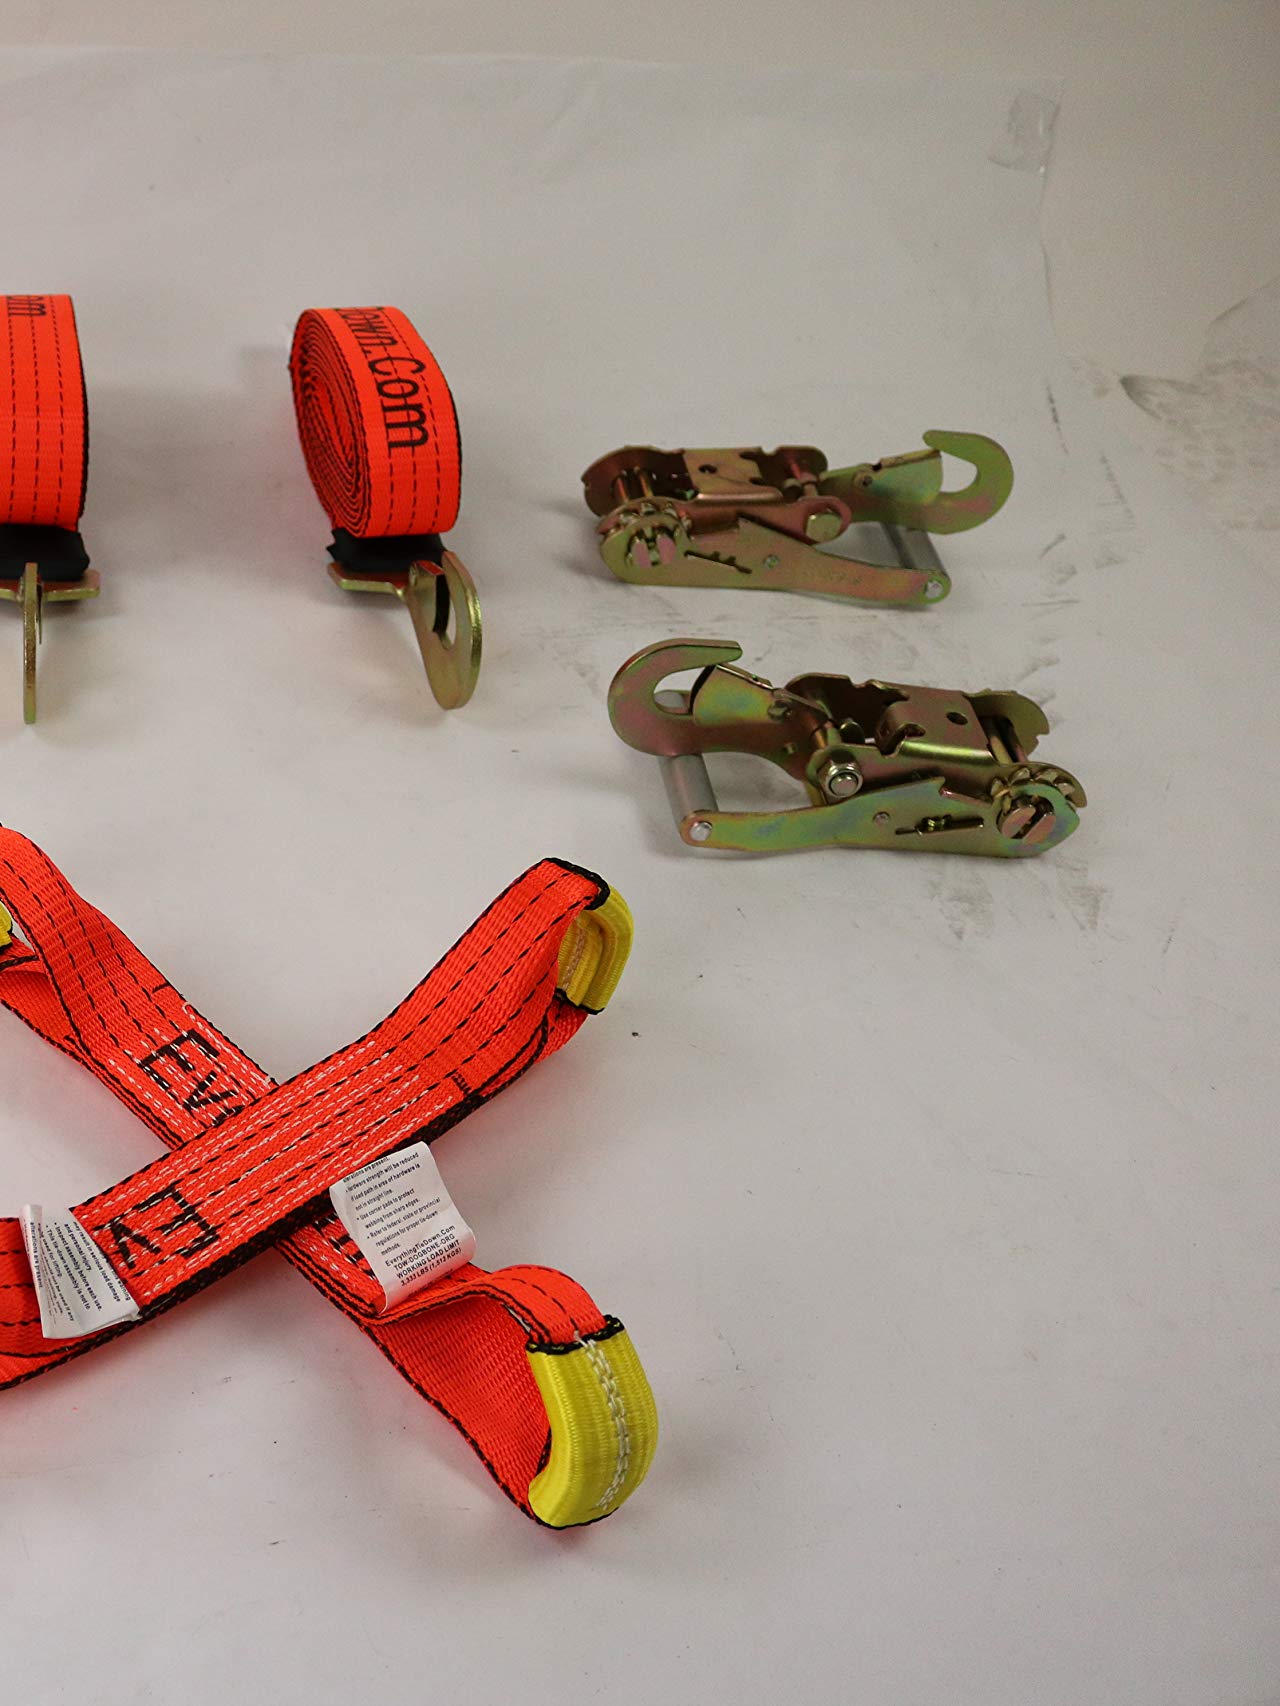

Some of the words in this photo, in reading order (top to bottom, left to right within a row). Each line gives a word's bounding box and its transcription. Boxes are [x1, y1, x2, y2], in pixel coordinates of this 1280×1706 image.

[333, 308, 429, 449] own.Com
[353, 1191, 363, 1199] load
[362, 1186, 373, 1195] path
[378, 1179, 388, 1187] area
[392, 1165, 415, 1179] hardware
[365, 1169, 384, 1183] strength
[383, 1165, 393, 1173] will
[398, 1152, 419, 1165] reduced
[364, 1216, 383, 1229] webbing
[382, 1211, 393, 1219] from
[392, 1204, 405, 1215] sharp
[404, 1196, 420, 1208] edges.
[366, 1192, 384, 1205] straight
[368, 1205, 382, 1215] corner
[381, 1199, 393, 1209] pads
[397, 1188, 415, 1200] protect
[369, 1227, 382, 1237] Refer
[402, 1211, 413, 1220] state
[417, 1197, 441, 1213] provincial
[29, 1221, 37, 1253] alterations
[63, 1222, 72, 1233] and
[68, 1232, 84, 1256] personal
[80, 1255, 93, 1272] injury.
[374, 1230, 400, 1248] regulations
[405, 1220, 421, 1232] proper
[418, 1210, 438, 1223] tie-down
[385, 1224, 455, 1267] EverythingTieDown.Com
[46, 1229, 55, 1241] This
[51, 1240, 67, 1264] tie-down
[62, 1263, 80, 1289] assembly
[79, 1293, 88, 1304] not
[84, 1302, 91, 1310] to
[53, 1226, 68, 1246] Inspect
[64, 1245, 81, 1270] assembly
[77, 1269, 90, 1286] before
[86, 1286, 97, 1299] each
[93, 1299, 102, 1311] use.
[78, 1230, 90, 1246] result
[90, 1250, 103, 1270] serious
[100, 1269, 110, 1281] load
[106, 1281, 120, 1302] damage
[394, 1233, 454, 1271] TOW-DOGBONE-ORG
[396, 1258, 426, 1278] WORKING
[426, 1248, 444, 1262] LOAD
[443, 1239, 460, 1252] LIMIT
[400, 1272, 416, 1287] 3,333
[415, 1265, 429, 1277] LBS
[445, 1247, 461, 1259] KGS)
[58, 1292, 68, 1306] used
